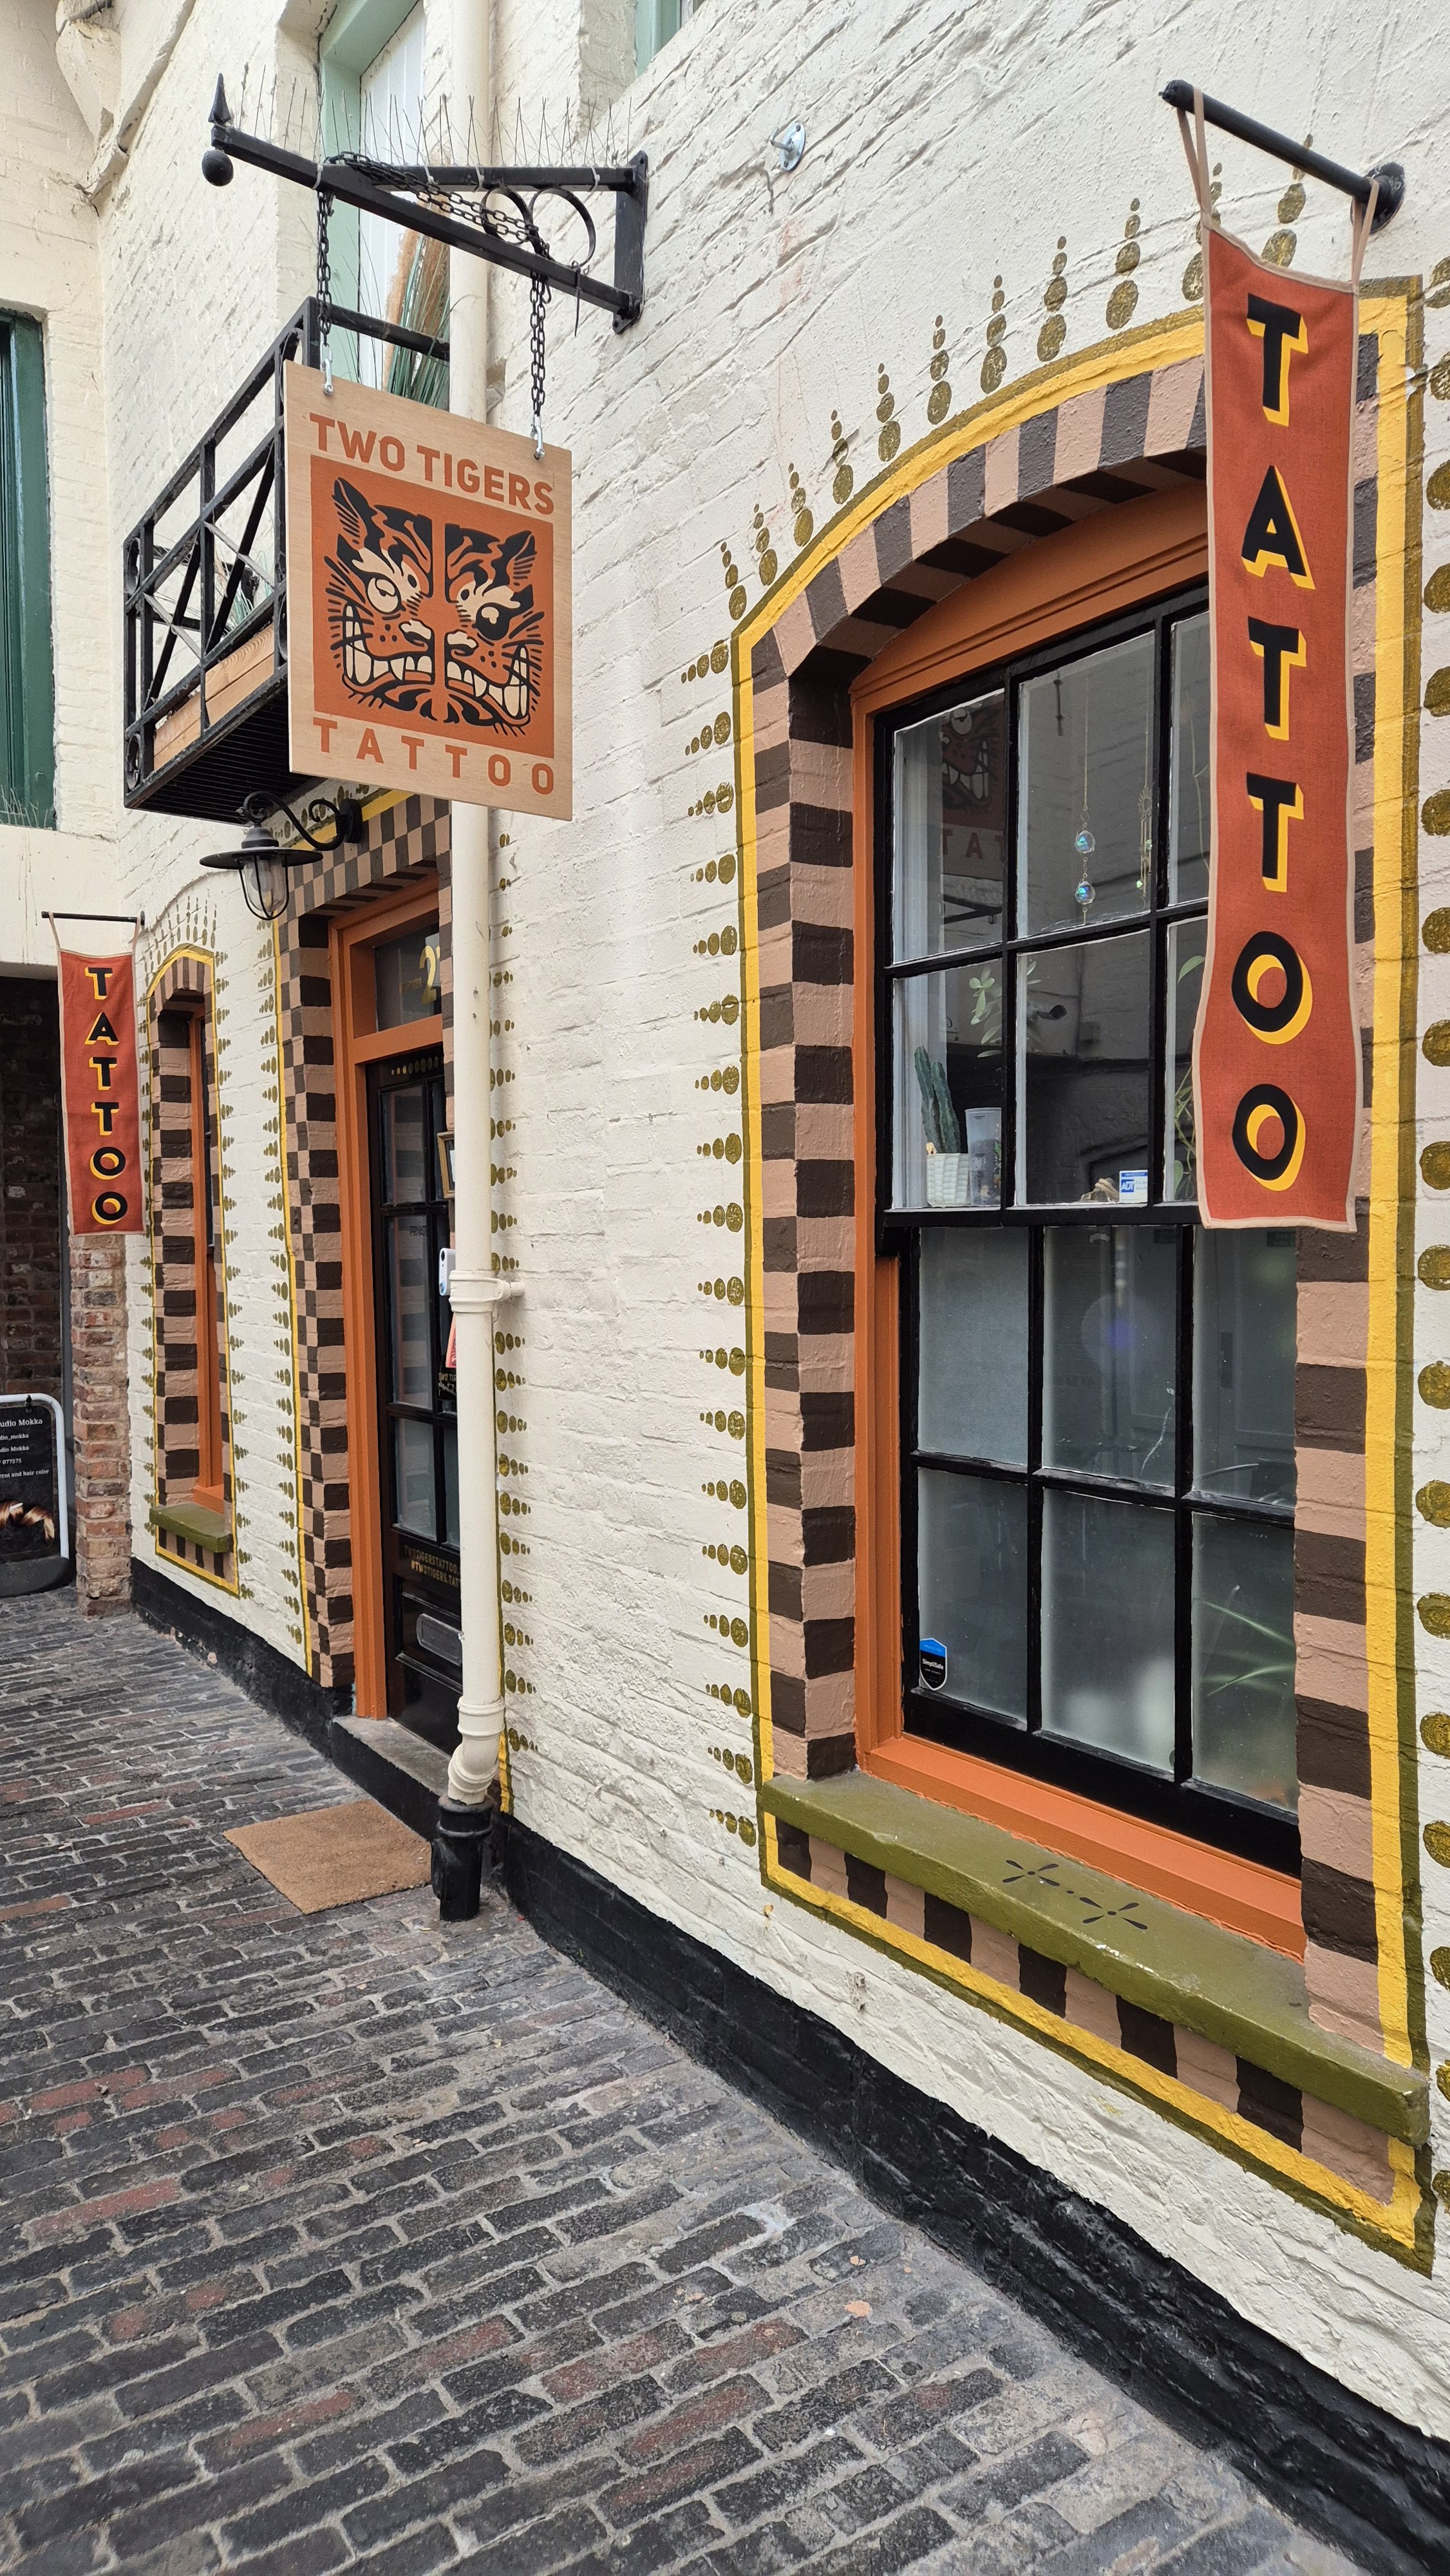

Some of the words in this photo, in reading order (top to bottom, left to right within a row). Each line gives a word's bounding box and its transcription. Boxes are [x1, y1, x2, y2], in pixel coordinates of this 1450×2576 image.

[310, 412, 405, 471] TWO
[417, 444, 554, 515] TIGERS
[313, 717, 554, 795] TATTOO
[1231, 294, 1315, 1191] TATTOO
[84, 967, 127, 1224] TATTOO
[1122, 1181, 1135, 1191] ADT
[18, 1418, 43, 1426] Mokka
